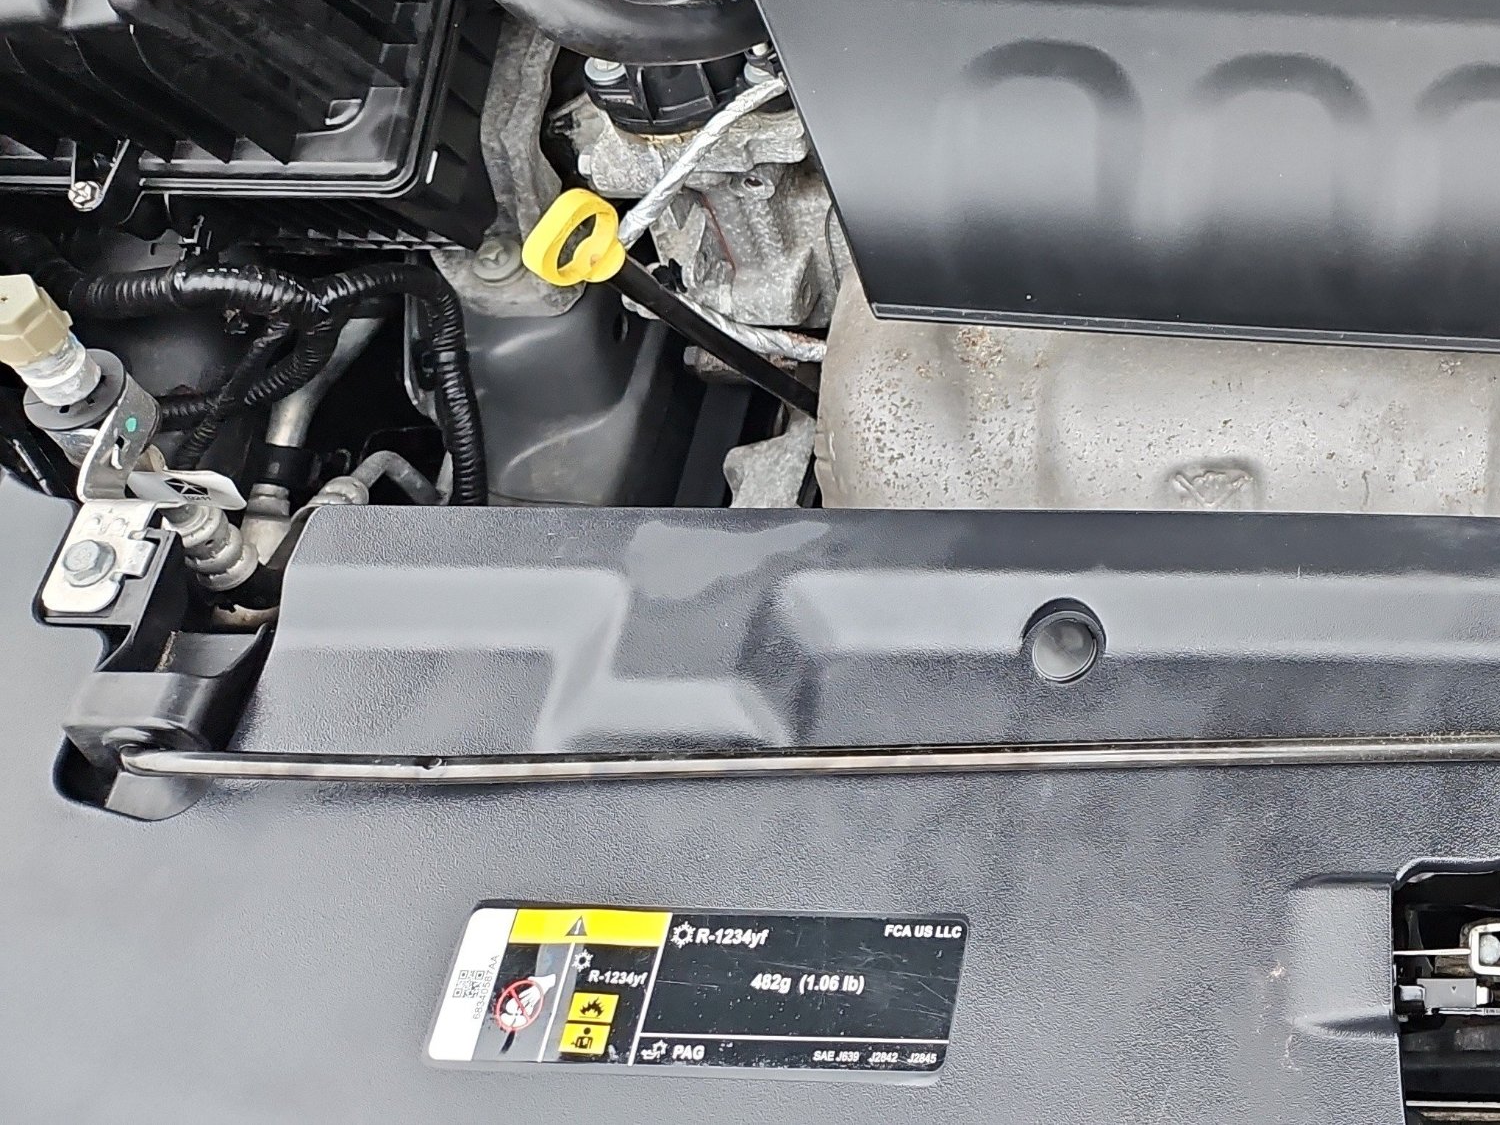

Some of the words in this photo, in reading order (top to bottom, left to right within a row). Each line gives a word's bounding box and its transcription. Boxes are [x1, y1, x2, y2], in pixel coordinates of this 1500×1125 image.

[696, 928, 769, 948] R-1234yf
[884, 925, 911, 937] FCA
[914, 925, 933, 938] US
[935, 925, 962, 938] LLC
[473, 954, 499, 1020] 68340587AA
[588, 969, 648, 987] R-1234yf
[750, 973, 791, 993] 482g
[799, 974, 840, 993] (1.06
[842, 975, 865, 994] lb)
[672, 1045, 705, 1060] PAG
[813, 1050, 835, 1062] SAE
[836, 1051, 860, 1062] J639
[868, 1052, 898, 1063] J2842
[907, 1052, 937, 1064] J2845
